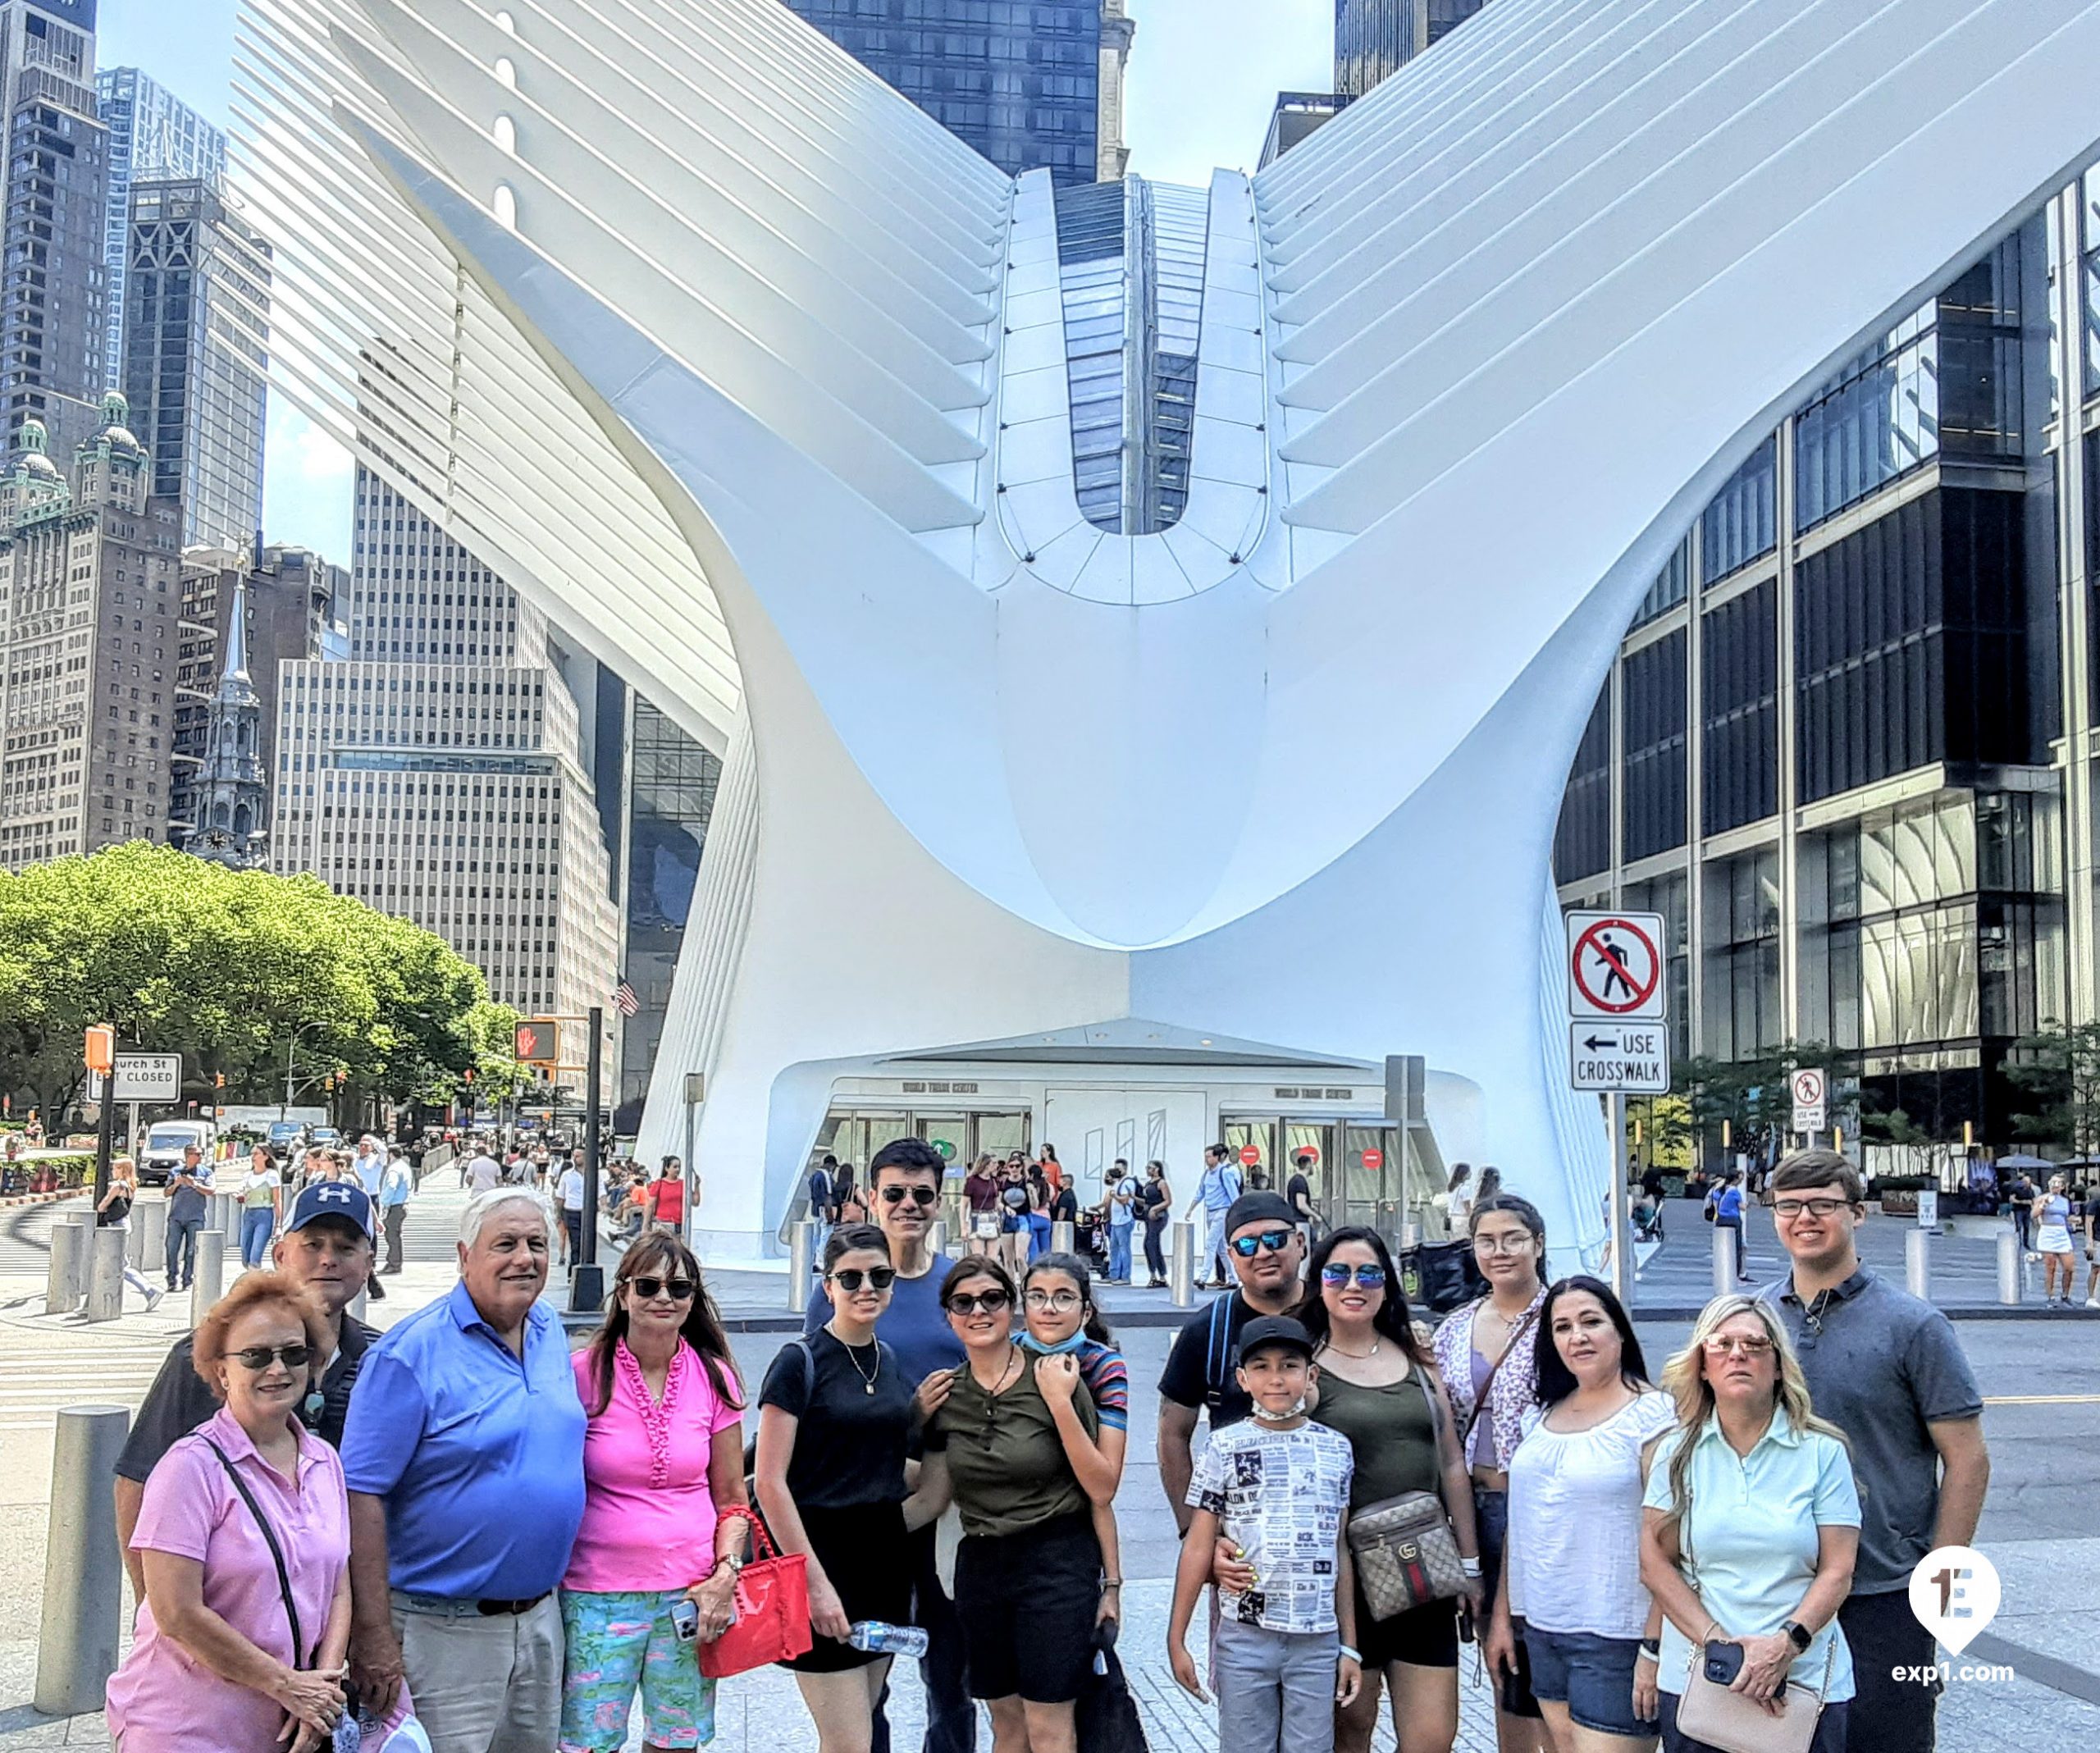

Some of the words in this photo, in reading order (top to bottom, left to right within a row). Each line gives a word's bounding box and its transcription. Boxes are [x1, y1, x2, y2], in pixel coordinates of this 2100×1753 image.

[1623, 1034, 1655, 1054] USE
[115, 1059, 148, 1069] hurch
[153, 1059, 167, 1069] St
[1578, 1061, 1660, 1081] CROSSWALK
[96, 1072, 121, 1082] ET
[126, 1072, 172, 1082] CLOSED
